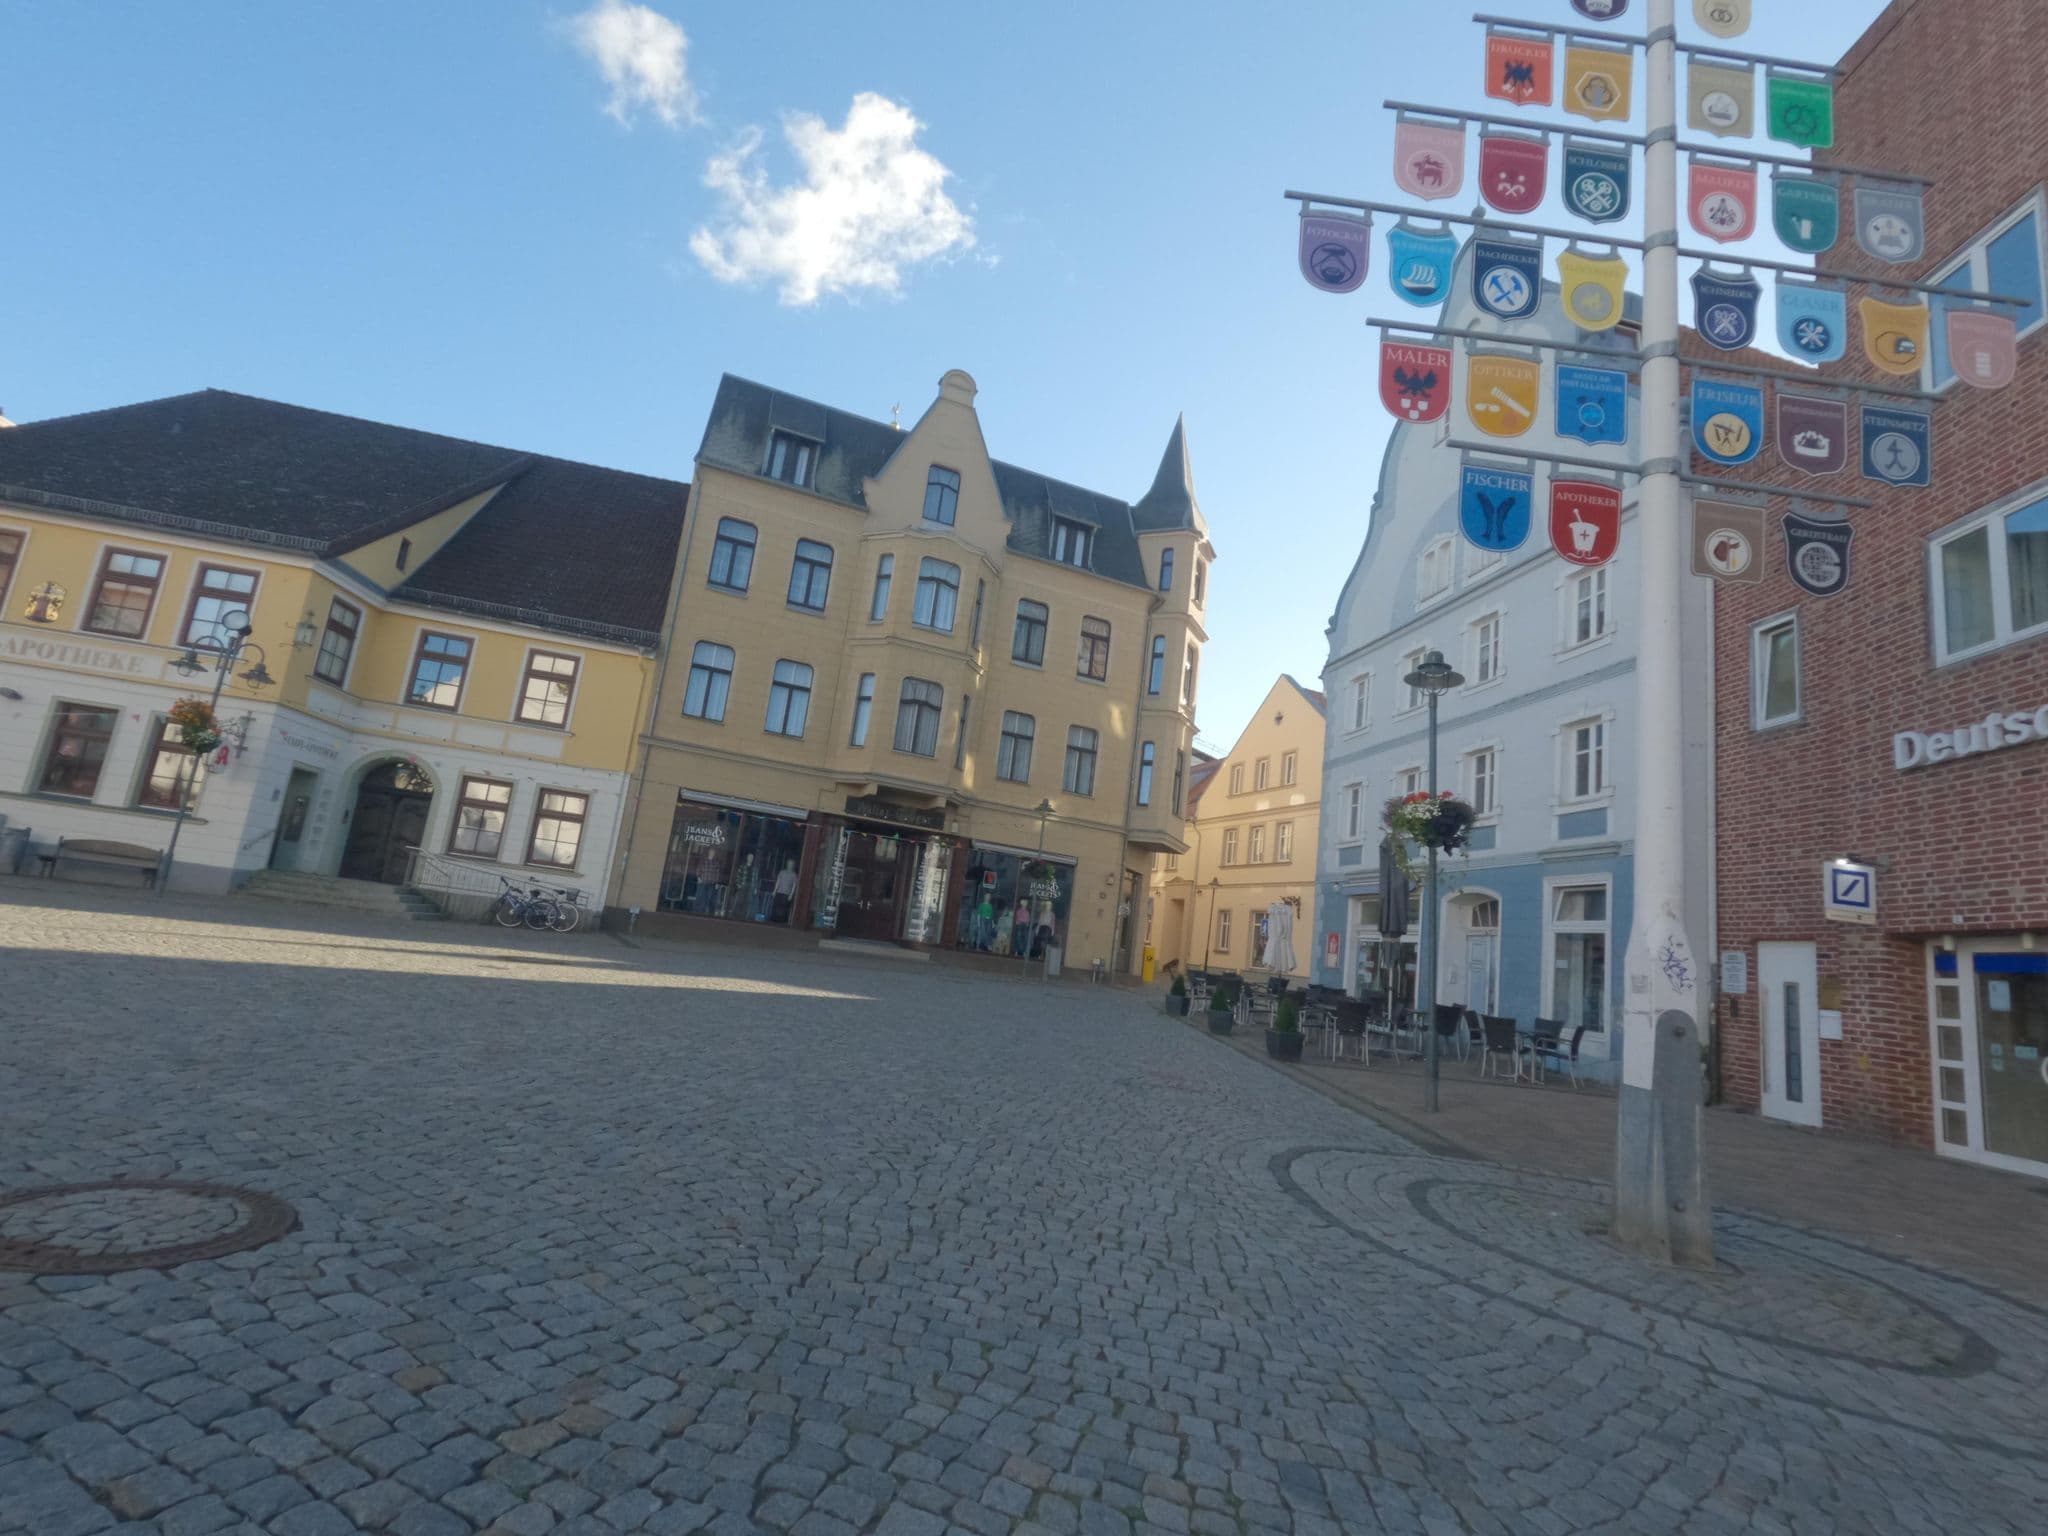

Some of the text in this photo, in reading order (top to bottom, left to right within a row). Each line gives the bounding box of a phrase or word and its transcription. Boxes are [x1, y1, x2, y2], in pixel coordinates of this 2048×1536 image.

[1489, 43, 1550, 58] DRUCKER
[1477, 248, 1539, 266] DACHDECKER
[1386, 347, 1449, 367] MALER
[1472, 363, 1535, 380] OPTIKER
[1697, 386, 1761, 406] FRISEUR
[1466, 471, 1530, 493] FISCHER
[1555, 491, 1618, 508] APOTHEKER
[685, 825, 712, 836] JEANS
[684, 834, 721, 845] JACKETS
